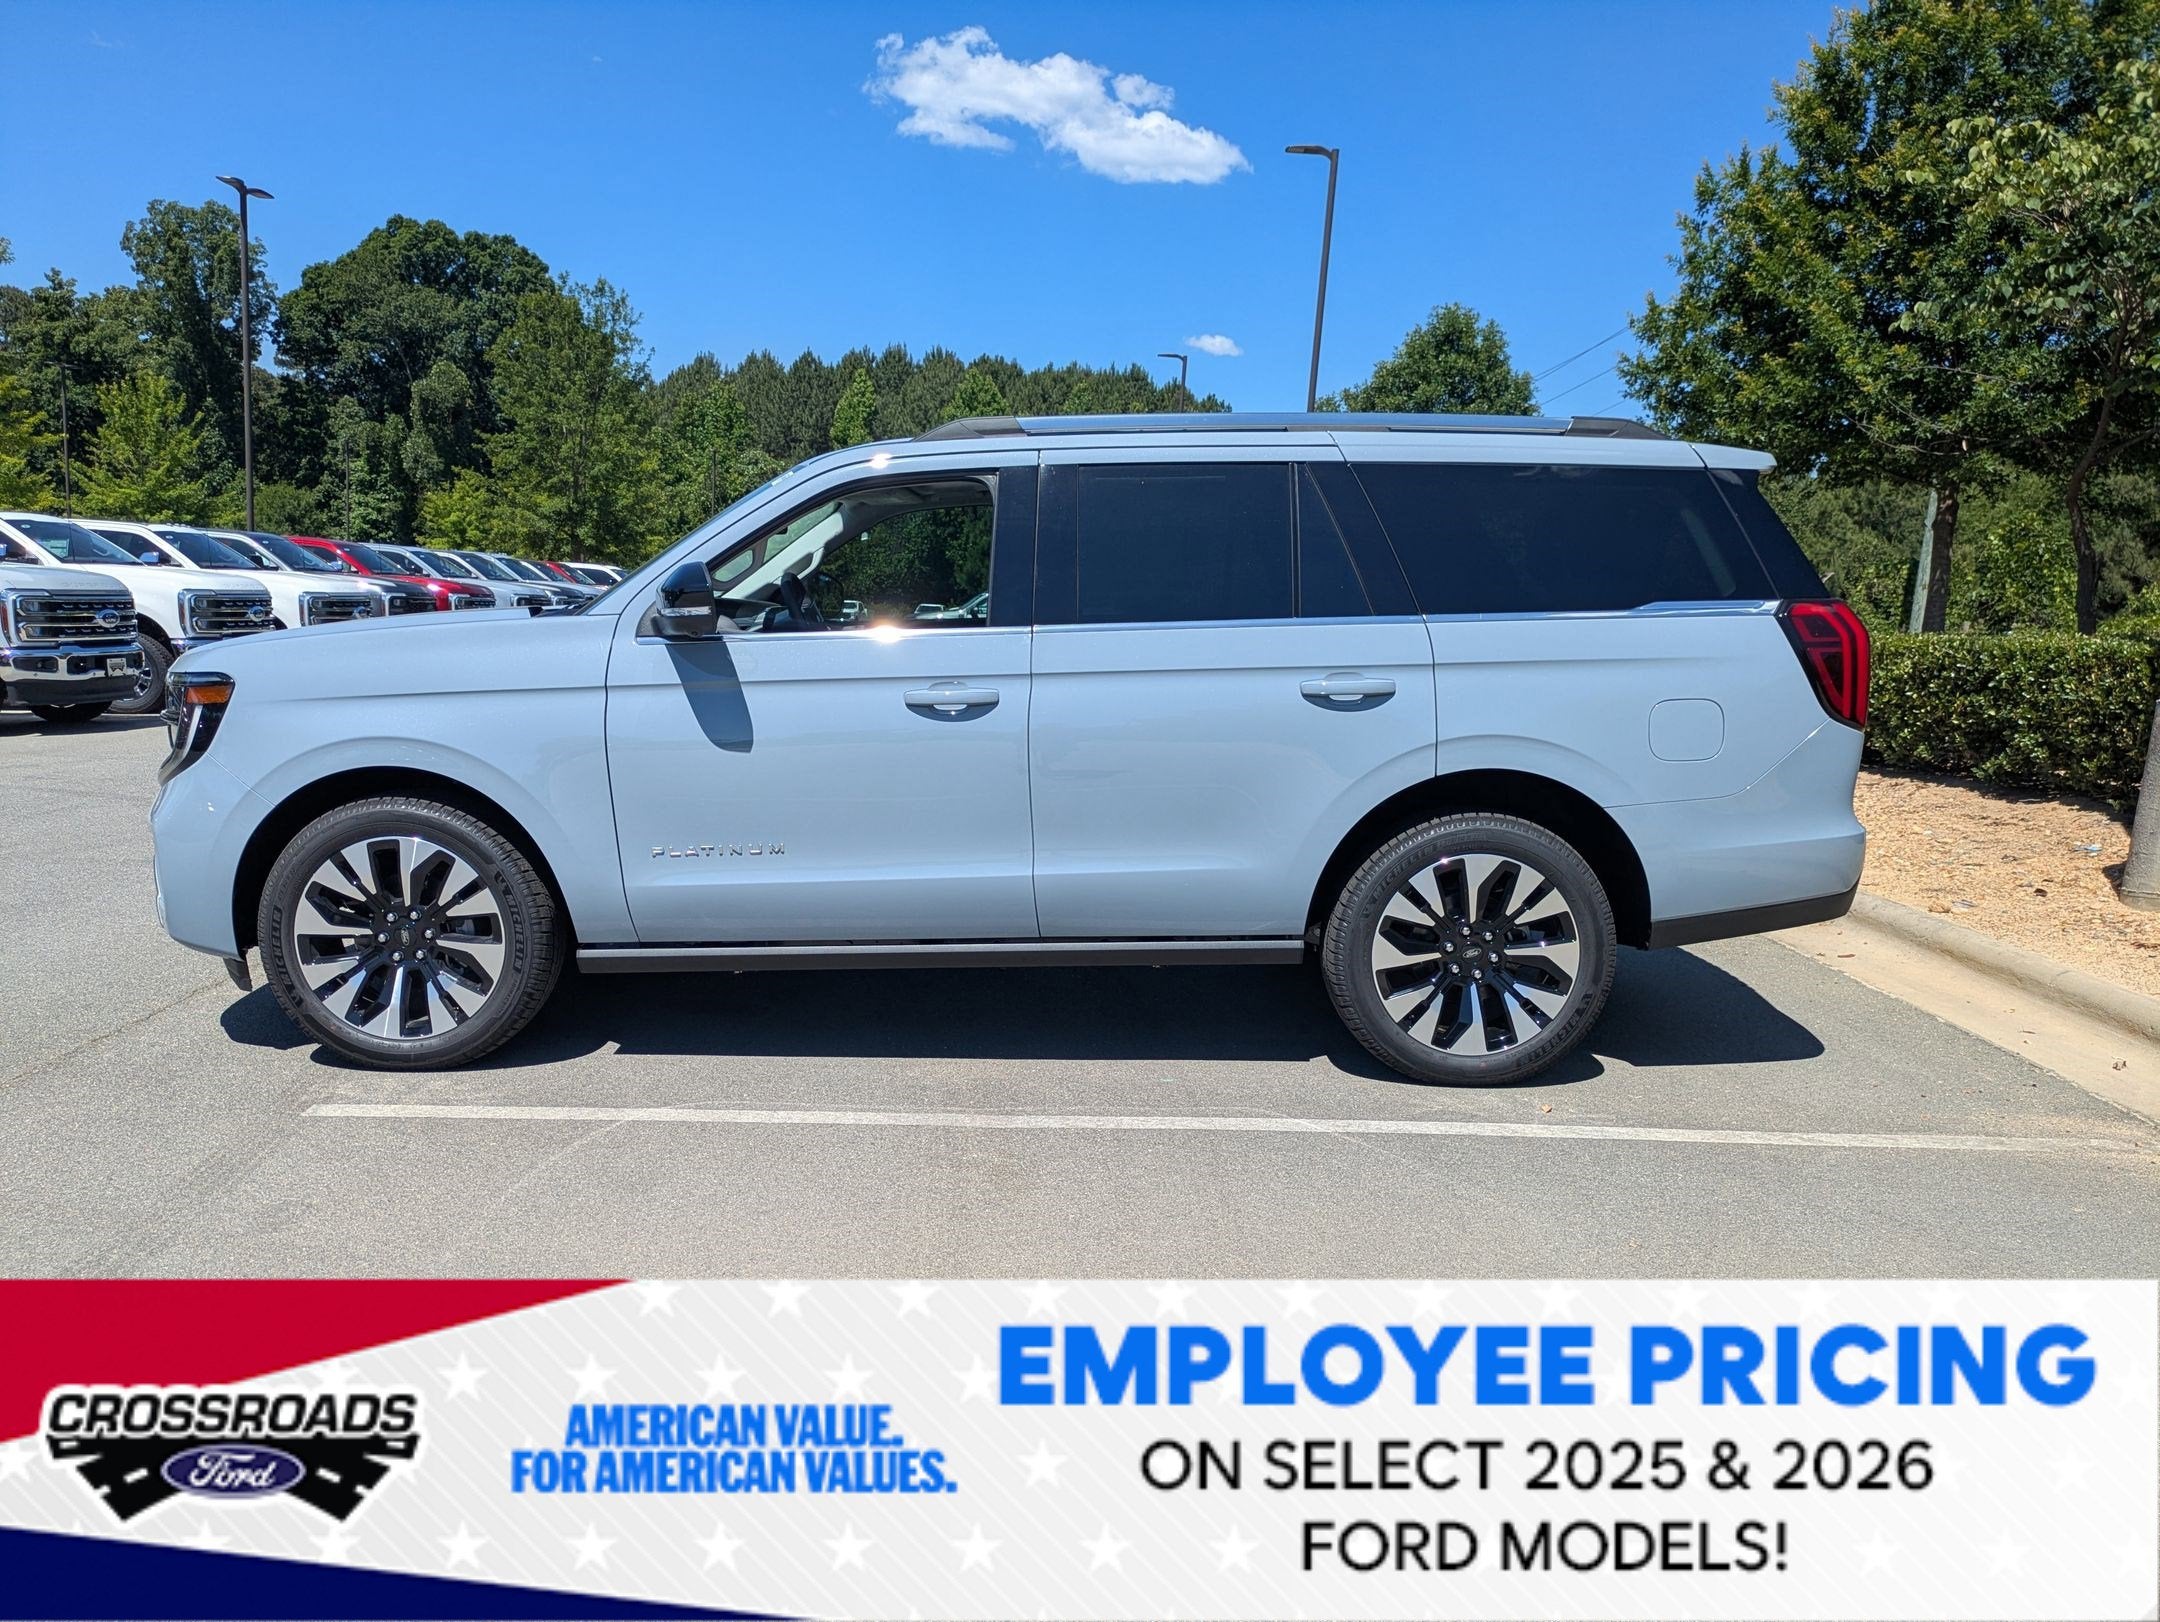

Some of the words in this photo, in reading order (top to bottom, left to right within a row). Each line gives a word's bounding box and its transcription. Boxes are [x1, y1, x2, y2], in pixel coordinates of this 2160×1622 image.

[651, 842, 785, 858] PLATINUM
[272, 909, 292, 985] MICHELIN
[505, 894, 524, 968] MICHELIN
